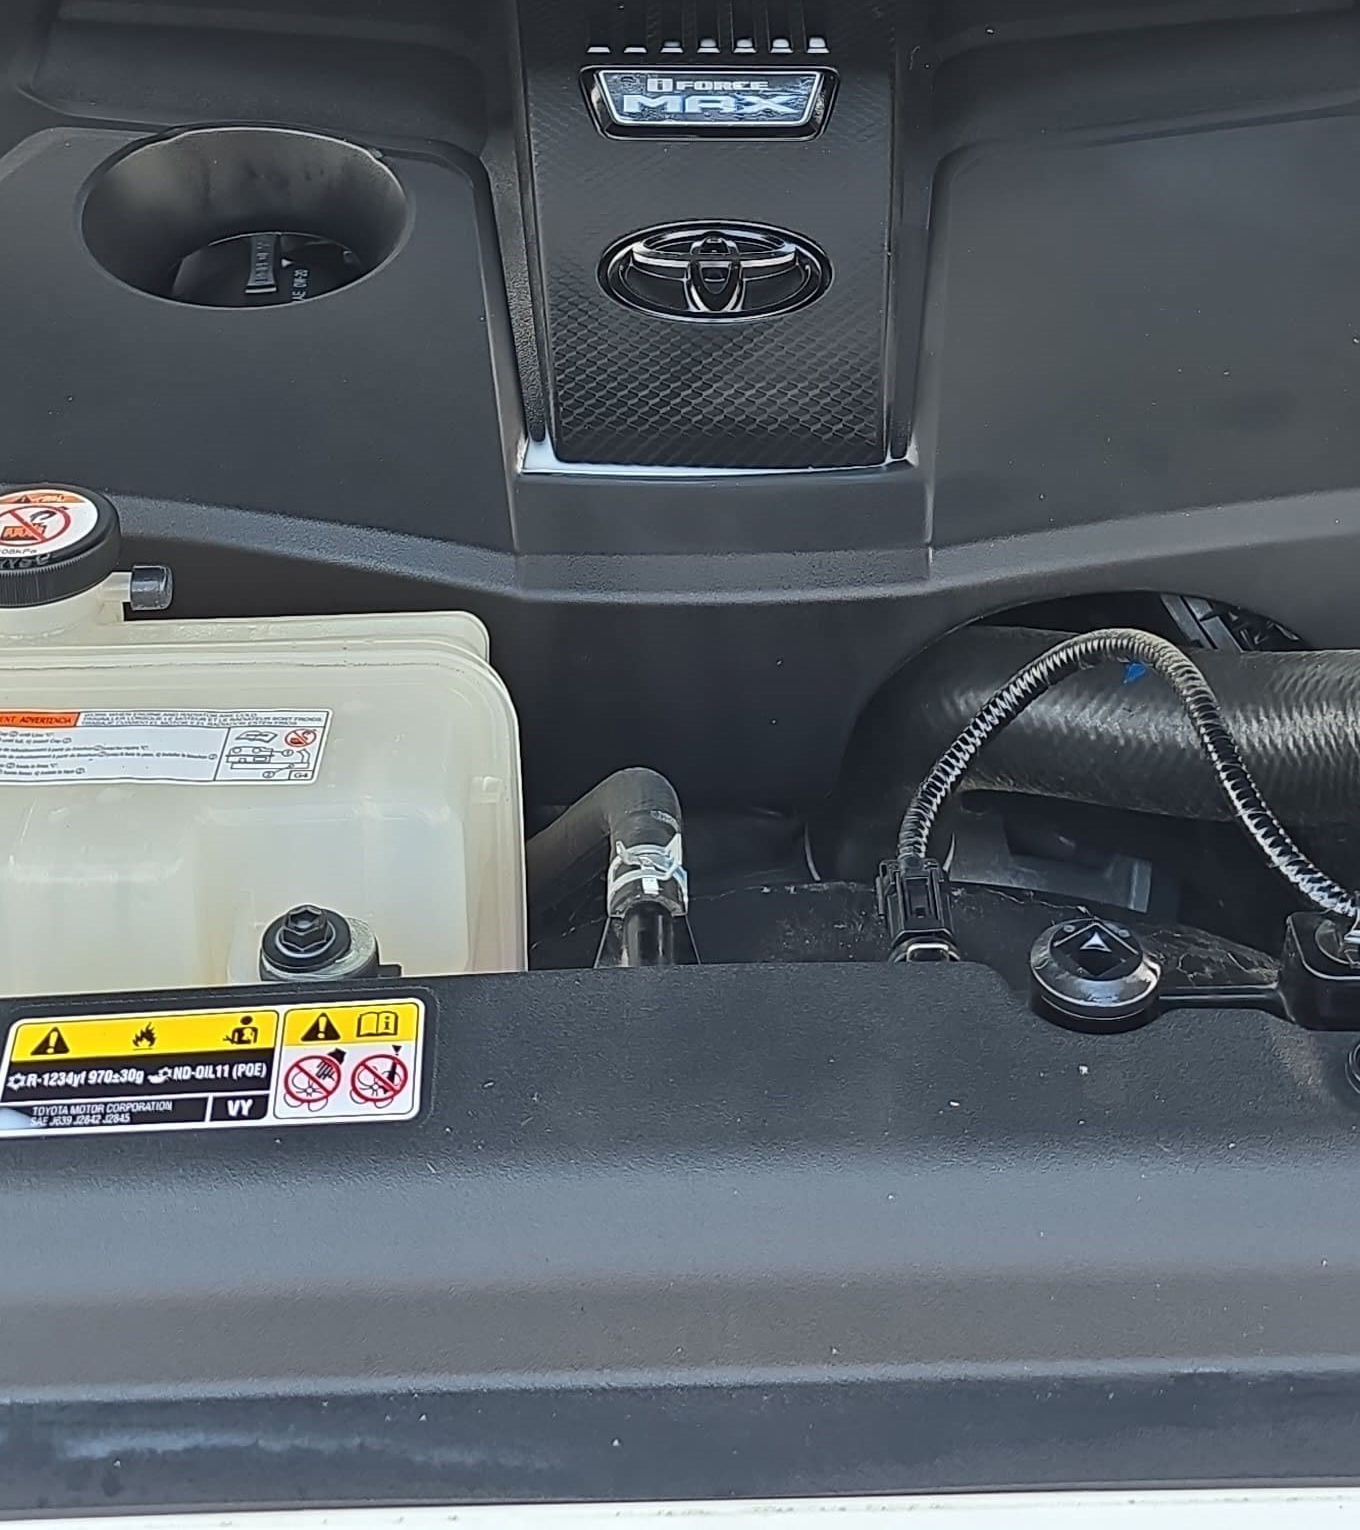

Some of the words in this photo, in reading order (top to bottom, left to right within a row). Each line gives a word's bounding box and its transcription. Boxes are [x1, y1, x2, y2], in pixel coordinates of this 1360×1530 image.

[623, 94, 799, 114] MAX
[26, 1070, 86, 1088] R-1234yf
[87, 1069, 145, 1084] 970±30g
[231, 1062, 267, 1080] (POE)
[32, 1105, 69, 1116] TOYOTA
[69, 1104, 105, 1115] MOTOR
[105, 1101, 173, 1113] CORPORATION
[227, 1099, 253, 1117] VY
[30, 1116, 48, 1127] SAE
